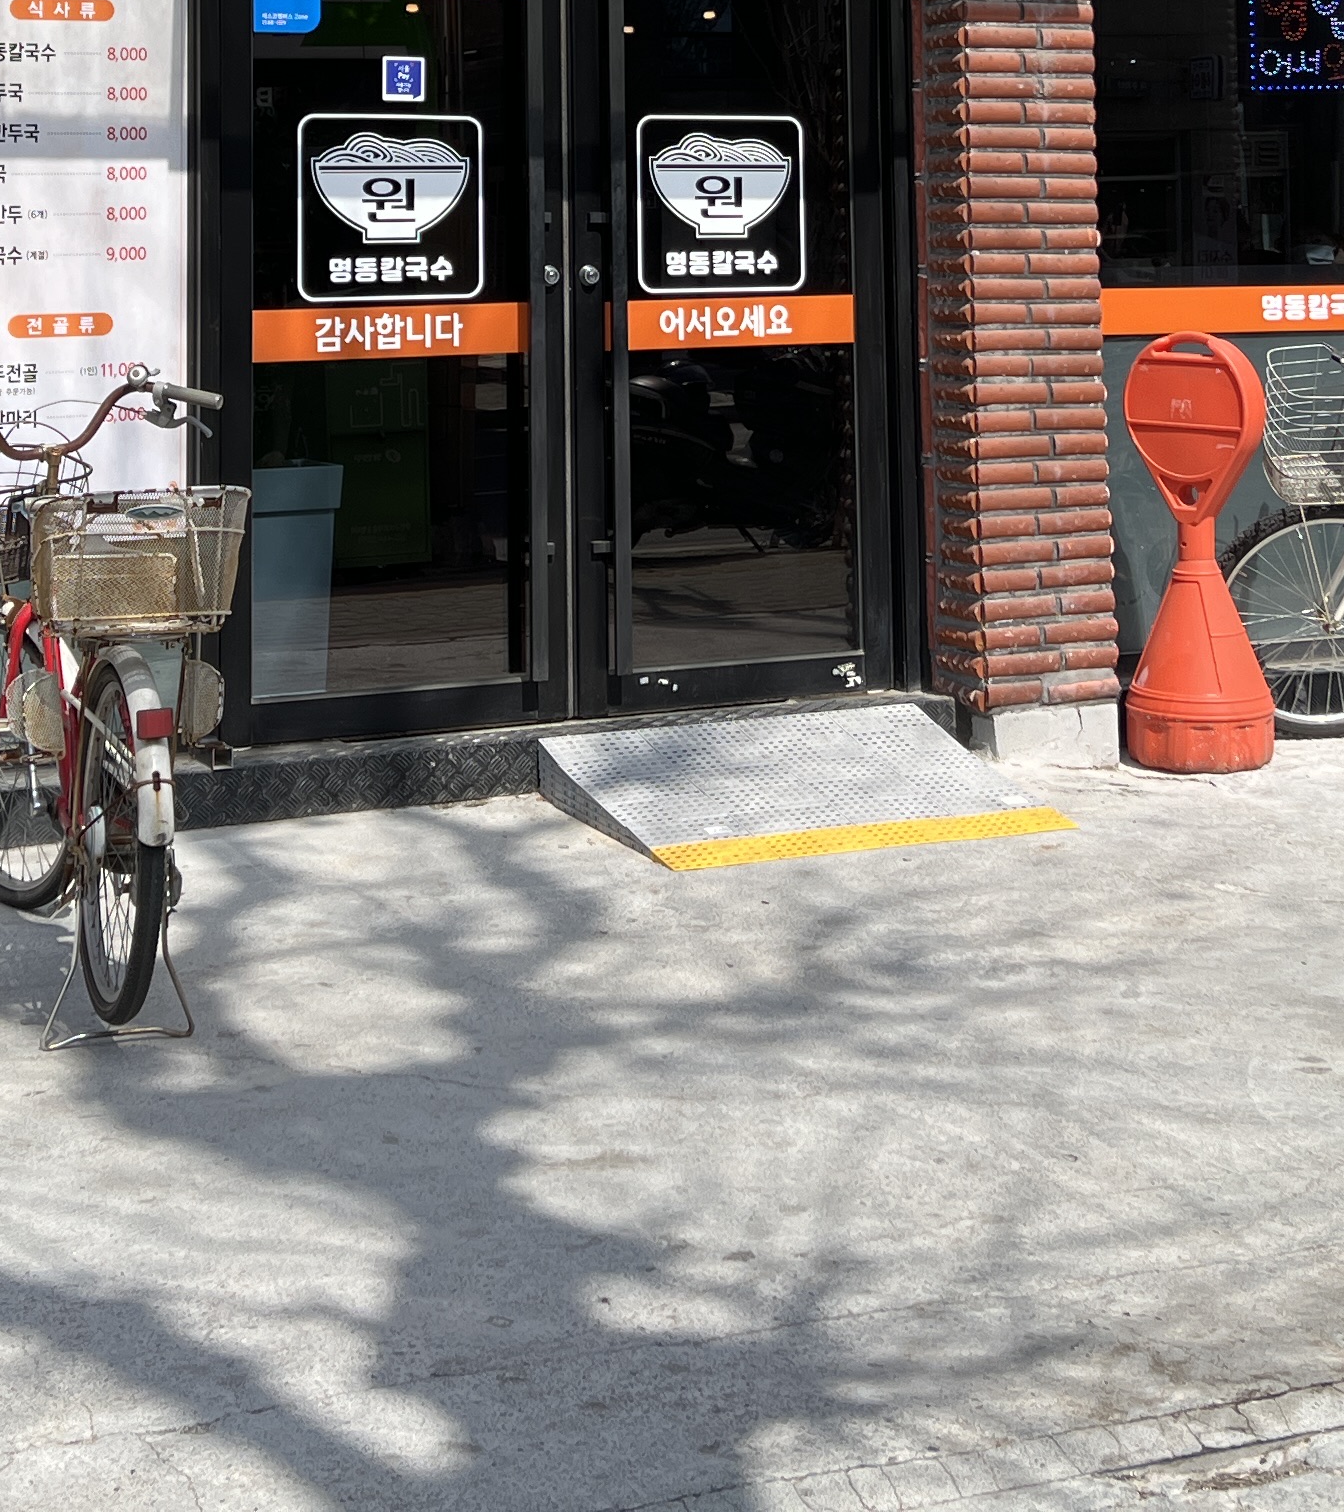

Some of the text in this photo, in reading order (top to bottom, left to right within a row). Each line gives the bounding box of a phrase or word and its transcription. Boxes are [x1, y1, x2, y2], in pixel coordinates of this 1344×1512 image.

[107, 47, 147, 62] 8,000
[107, 87, 147, 102] 8,000
[107, 126, 147, 142] 8,000
[107, 166, 147, 182] 8,000
[362, 178, 416, 223] 원
[694, 175, 744, 219] 원
[106, 206, 147, 222] 8,000
[106, 246, 147, 262] 9,000
[329, 256, 454, 284] 명동칼국수
[665, 249, 778, 276] 명동칼국수
[659, 304, 793, 341] 어서오세요
[315, 312, 464, 353] 감사합니다
[101, 362, 144, 378] 11,0
[104, 407, 145, 424] 5,000
